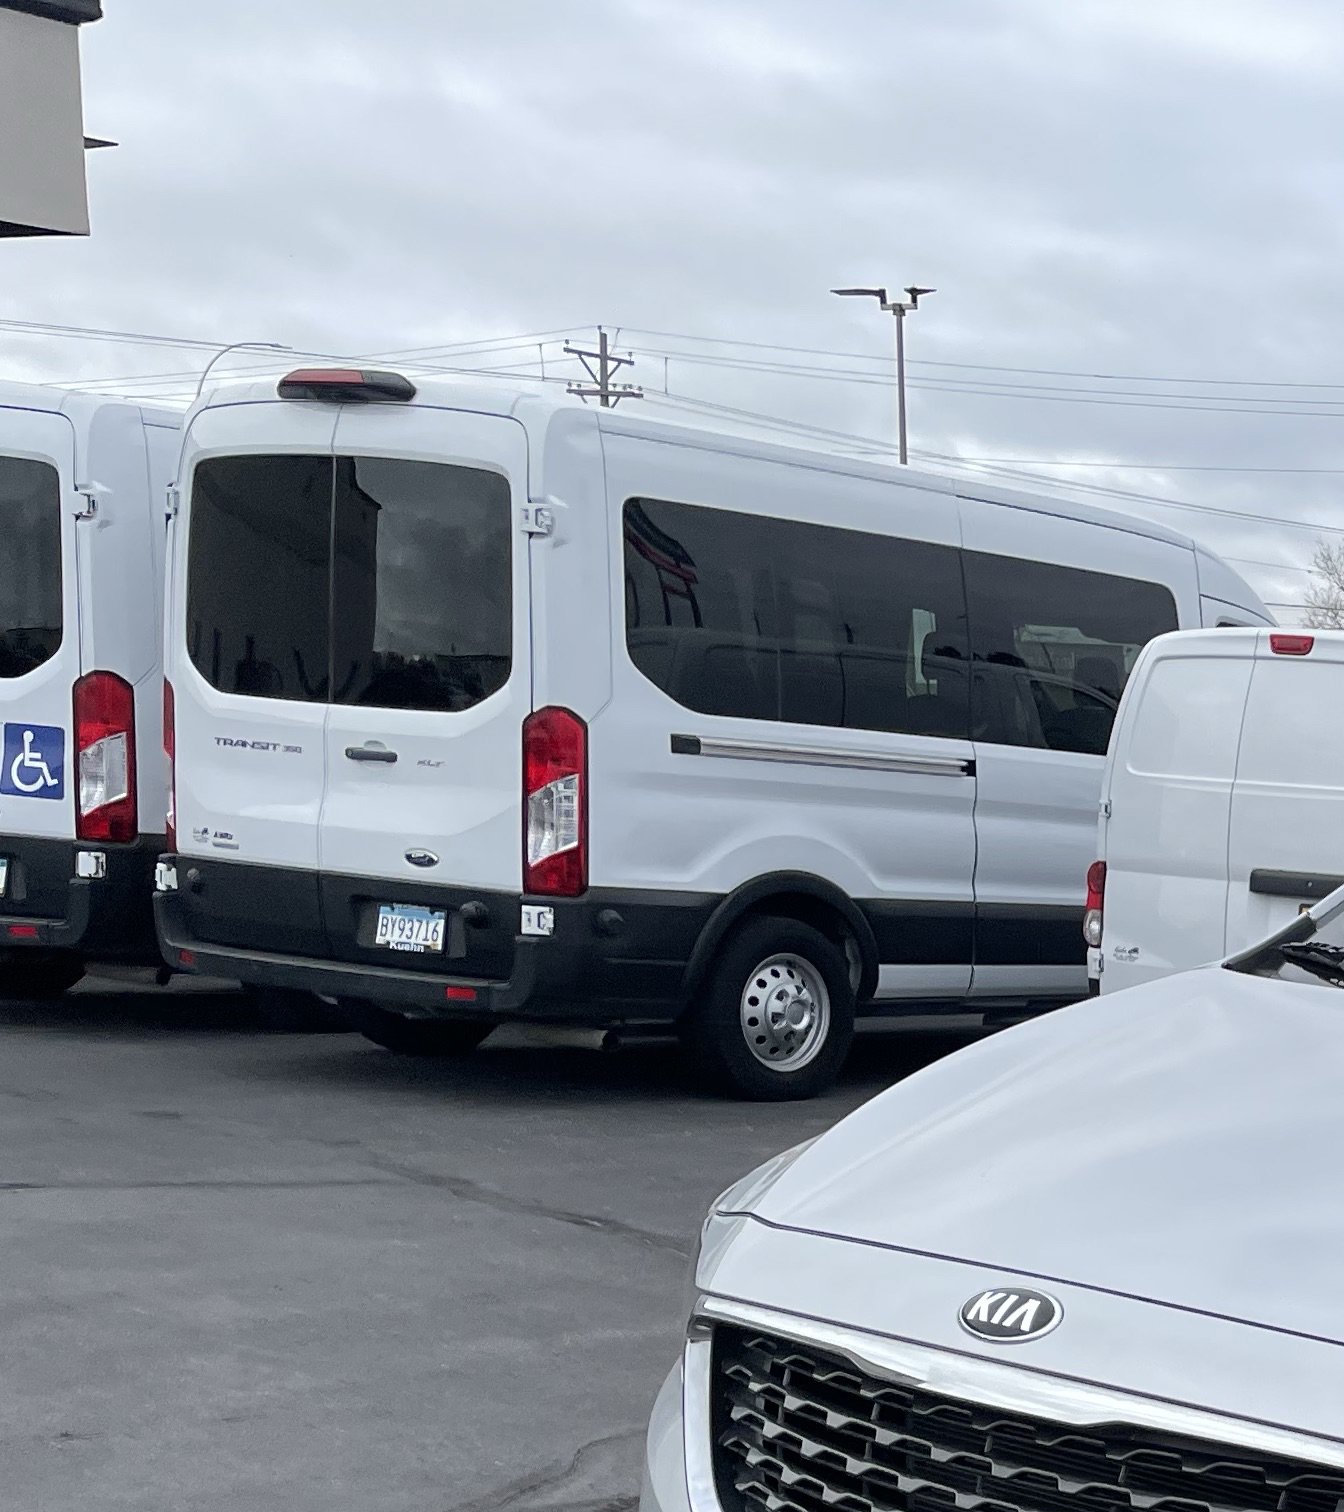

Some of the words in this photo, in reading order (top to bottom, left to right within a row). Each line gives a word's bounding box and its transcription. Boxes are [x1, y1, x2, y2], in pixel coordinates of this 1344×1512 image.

[214, 736, 281, 753] TRANSIT
[379, 916, 440, 942] BY93716
[966, 1291, 1041, 1332] KIA
